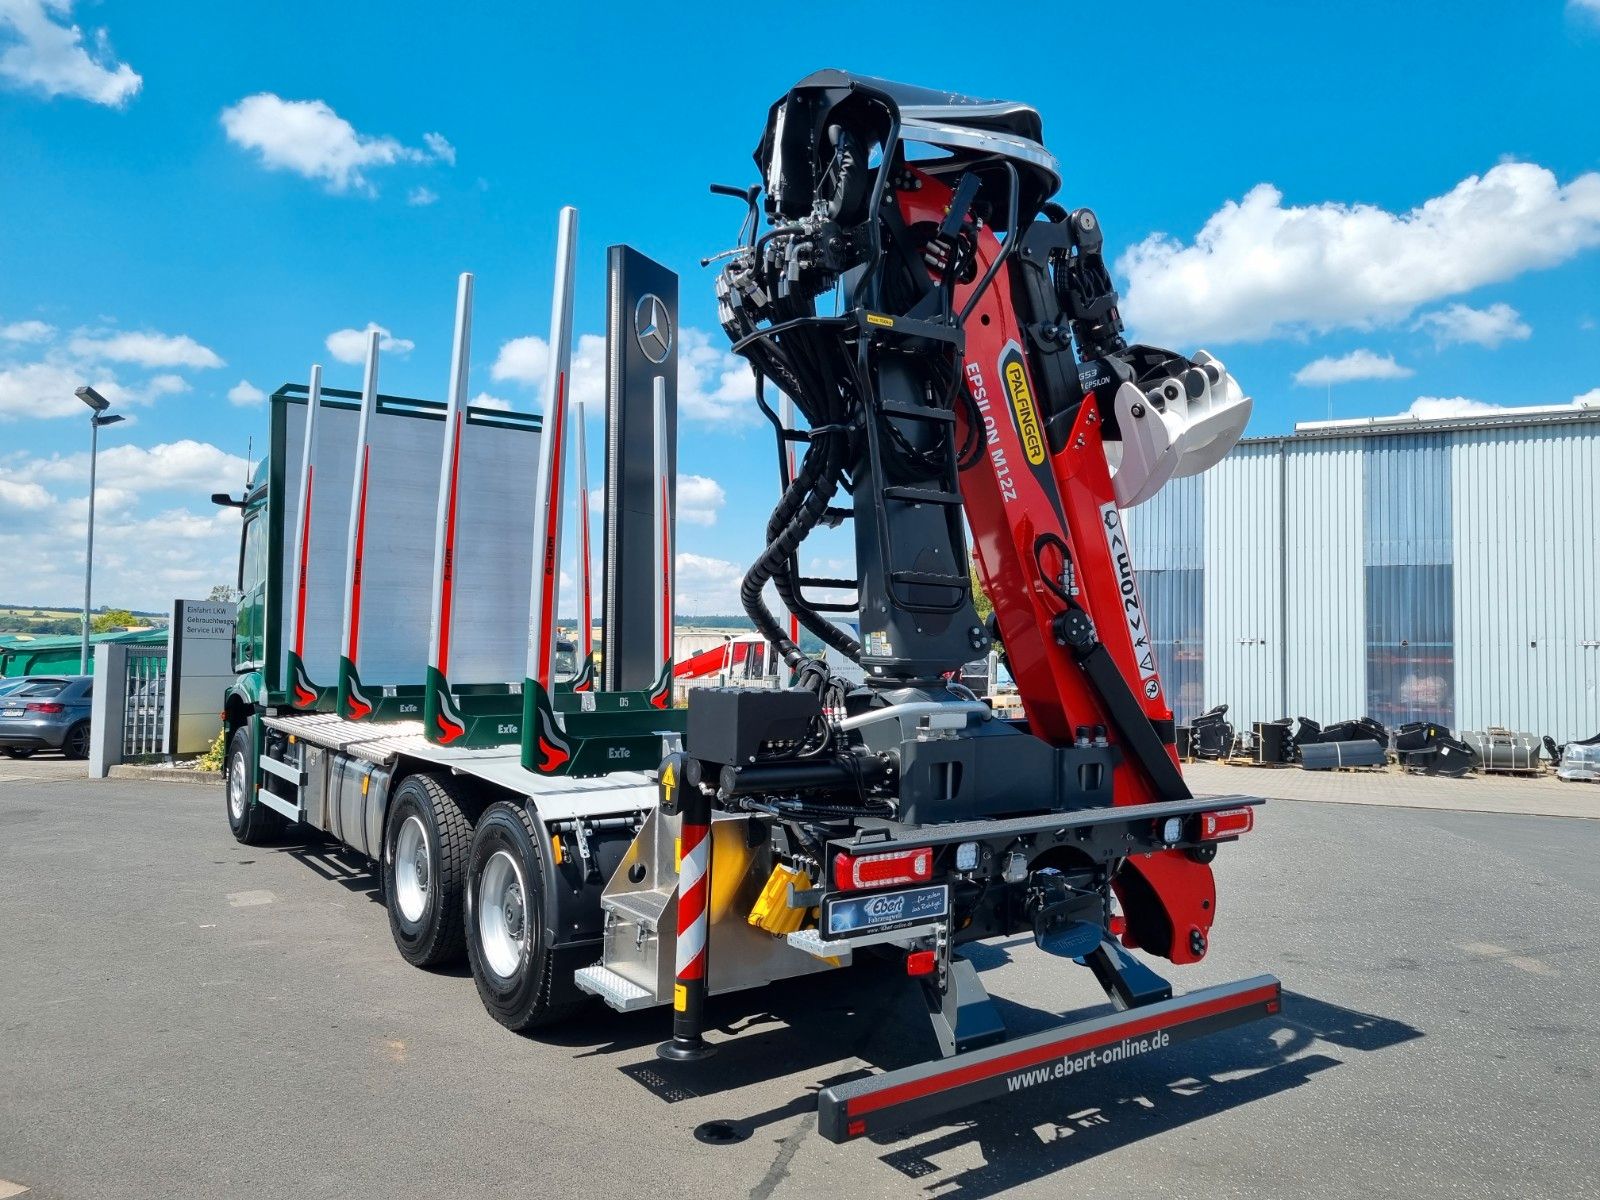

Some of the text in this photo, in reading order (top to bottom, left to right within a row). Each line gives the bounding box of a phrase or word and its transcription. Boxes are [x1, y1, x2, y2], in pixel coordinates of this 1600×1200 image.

[1084, 375, 1111, 390] EPSILON
[1008, 367, 1041, 459] PALFINGER
[966, 362, 1018, 503] EPSILON M12Z
[187, 606, 211, 614] Einfahrt
[187, 616, 234, 625] Gebrauchtwage
[399, 703, 418, 713] ExTe
[497, 724, 518, 734] ExTe
[608, 746, 631, 759] ExTe
[872, 898, 903, 914] Ebert
[1006, 1030, 1170, 1092] www.ebert-online.de
